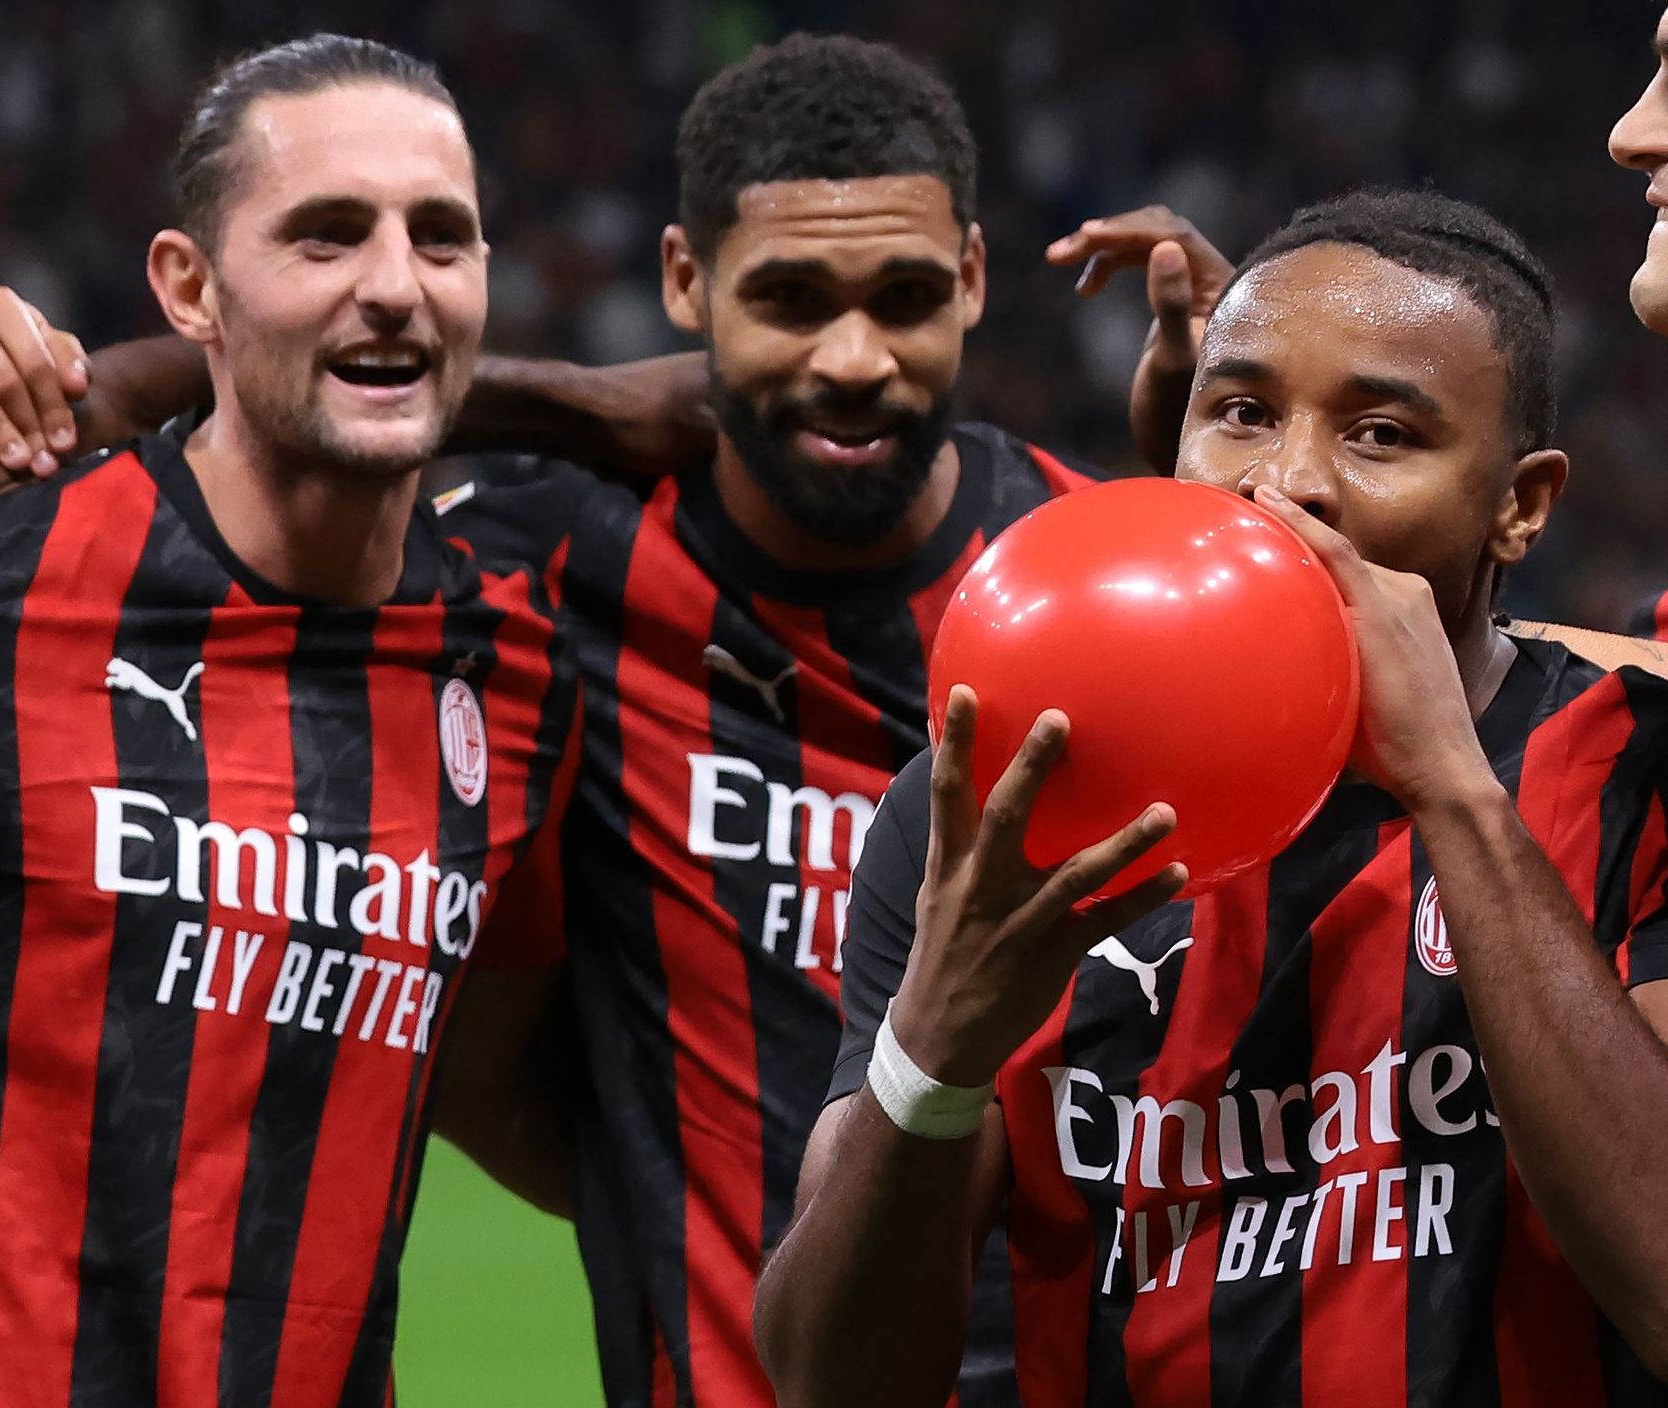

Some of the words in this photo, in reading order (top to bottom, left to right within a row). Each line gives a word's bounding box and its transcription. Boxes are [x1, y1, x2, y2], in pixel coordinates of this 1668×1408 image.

[89, 785, 488, 960] Emirates
[156, 920, 265, 1016] FLY
[265, 941, 444, 1055] BETTER
[1101, 1200, 1201, 1295] FLY
[1216, 1162, 1455, 1283] BETTER
